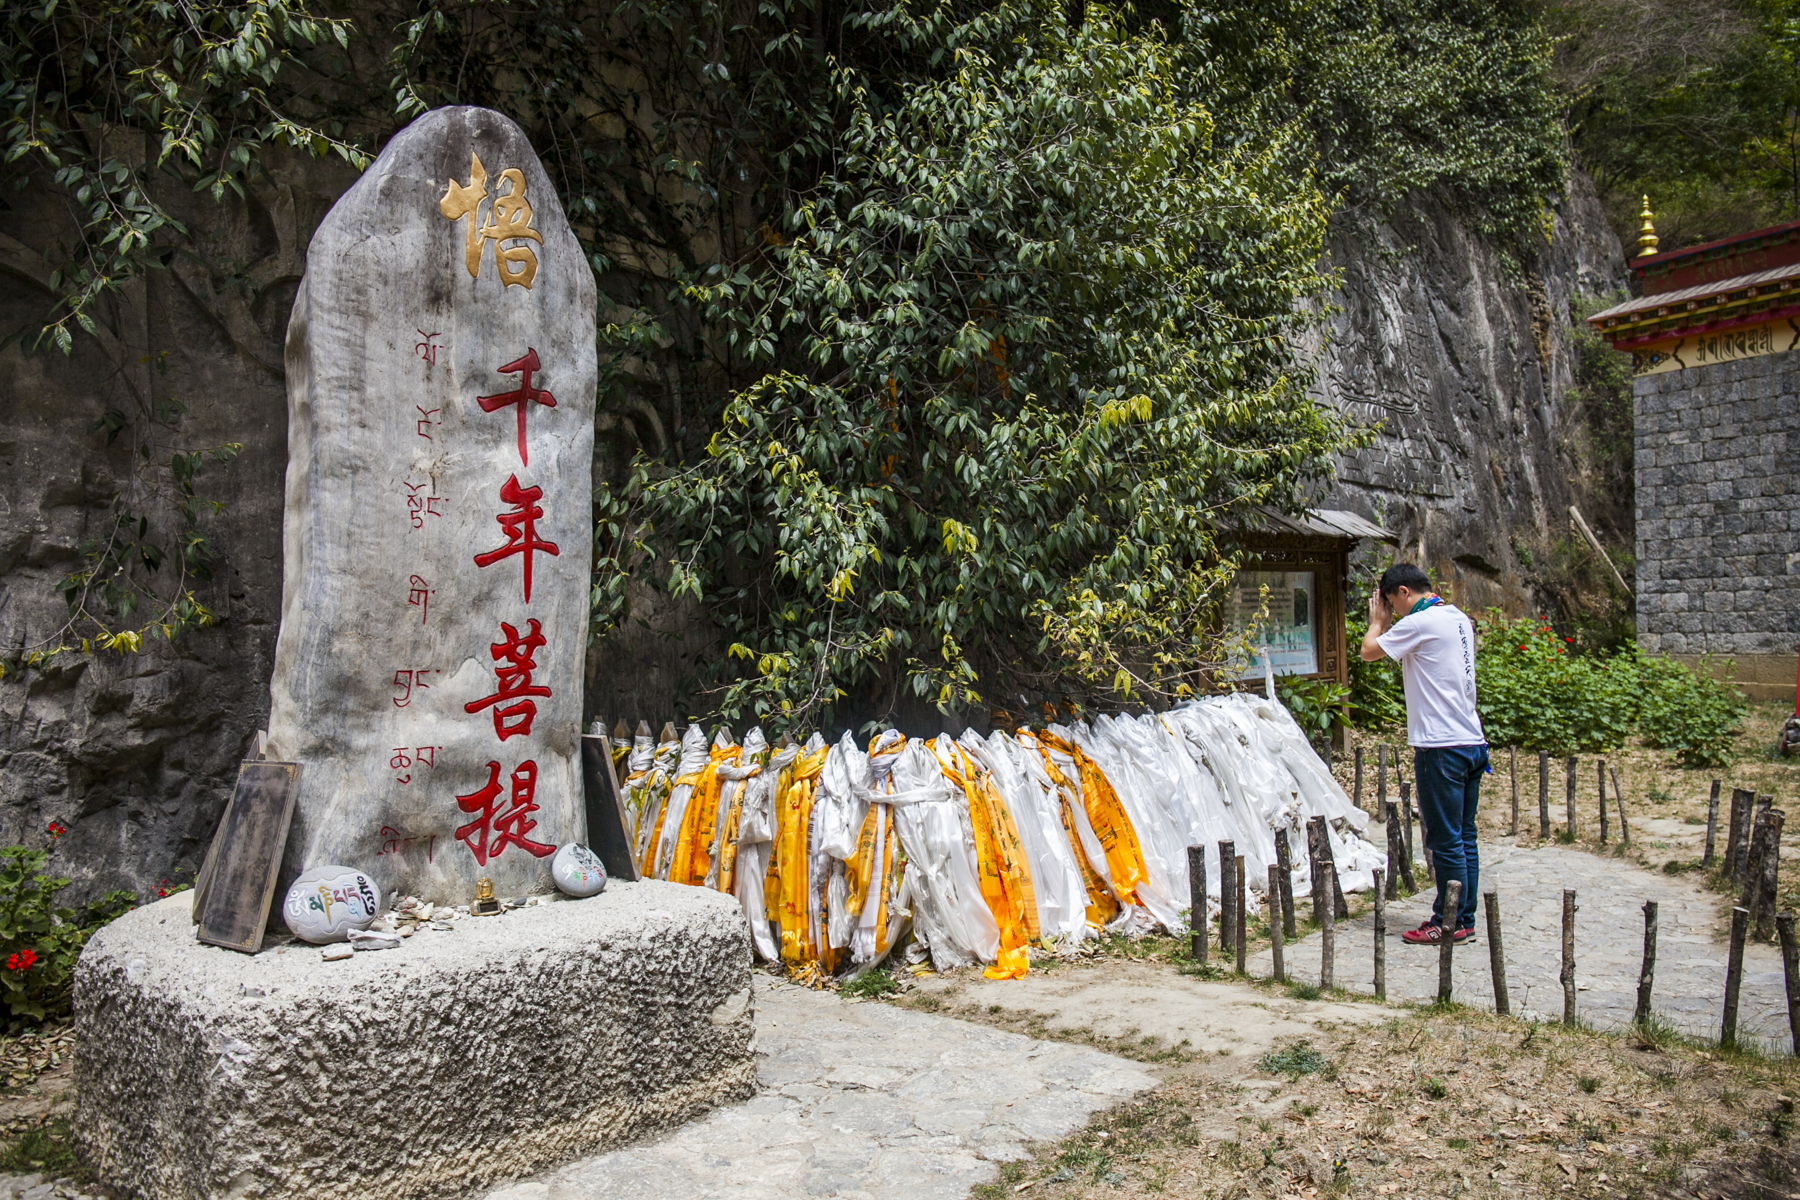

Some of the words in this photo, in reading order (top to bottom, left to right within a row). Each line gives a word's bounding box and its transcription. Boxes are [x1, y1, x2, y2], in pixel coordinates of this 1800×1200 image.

[440, 151, 544, 291] 悟
[454, 347, 559, 867] 千年菩提
